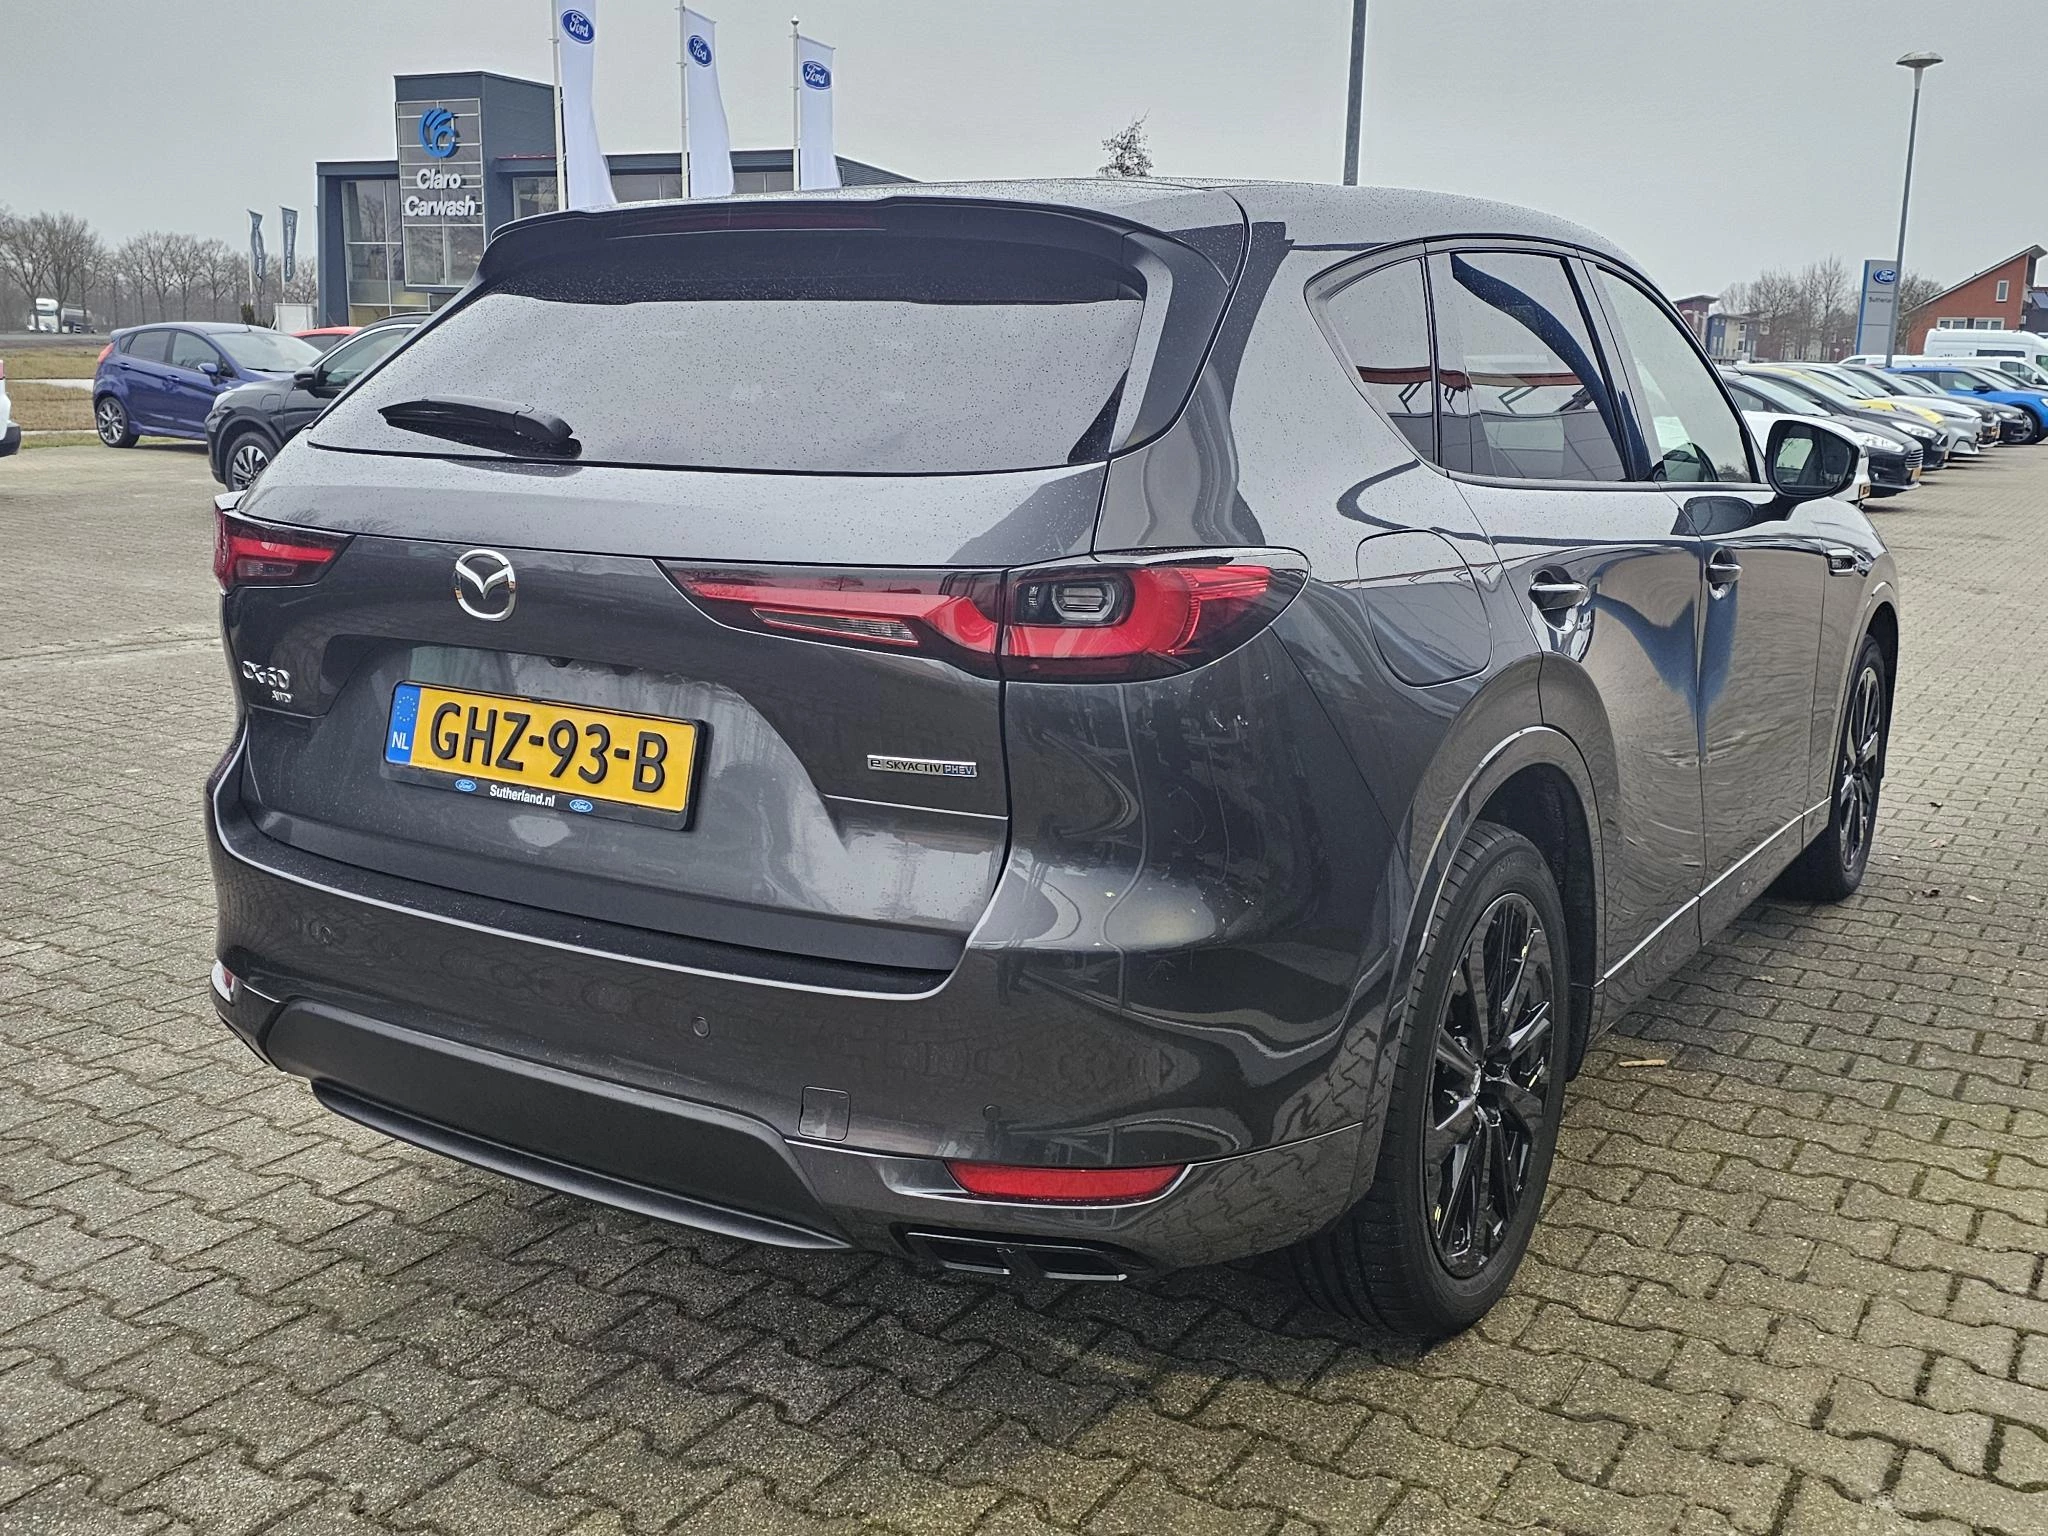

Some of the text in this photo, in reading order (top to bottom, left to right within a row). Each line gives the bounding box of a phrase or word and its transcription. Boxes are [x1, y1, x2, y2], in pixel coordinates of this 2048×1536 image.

[569, 13, 589, 38] Ford
[804, 64, 826, 85] Ford
[416, 168, 462, 189] Claro
[404, 194, 476, 217] Carwash
[391, 731, 409, 750] NL
[429, 702, 668, 794] GHZ-93-B
[944, 764, 974, 775] PHEV
[489, 784, 556, 807] Sutherland.nl
